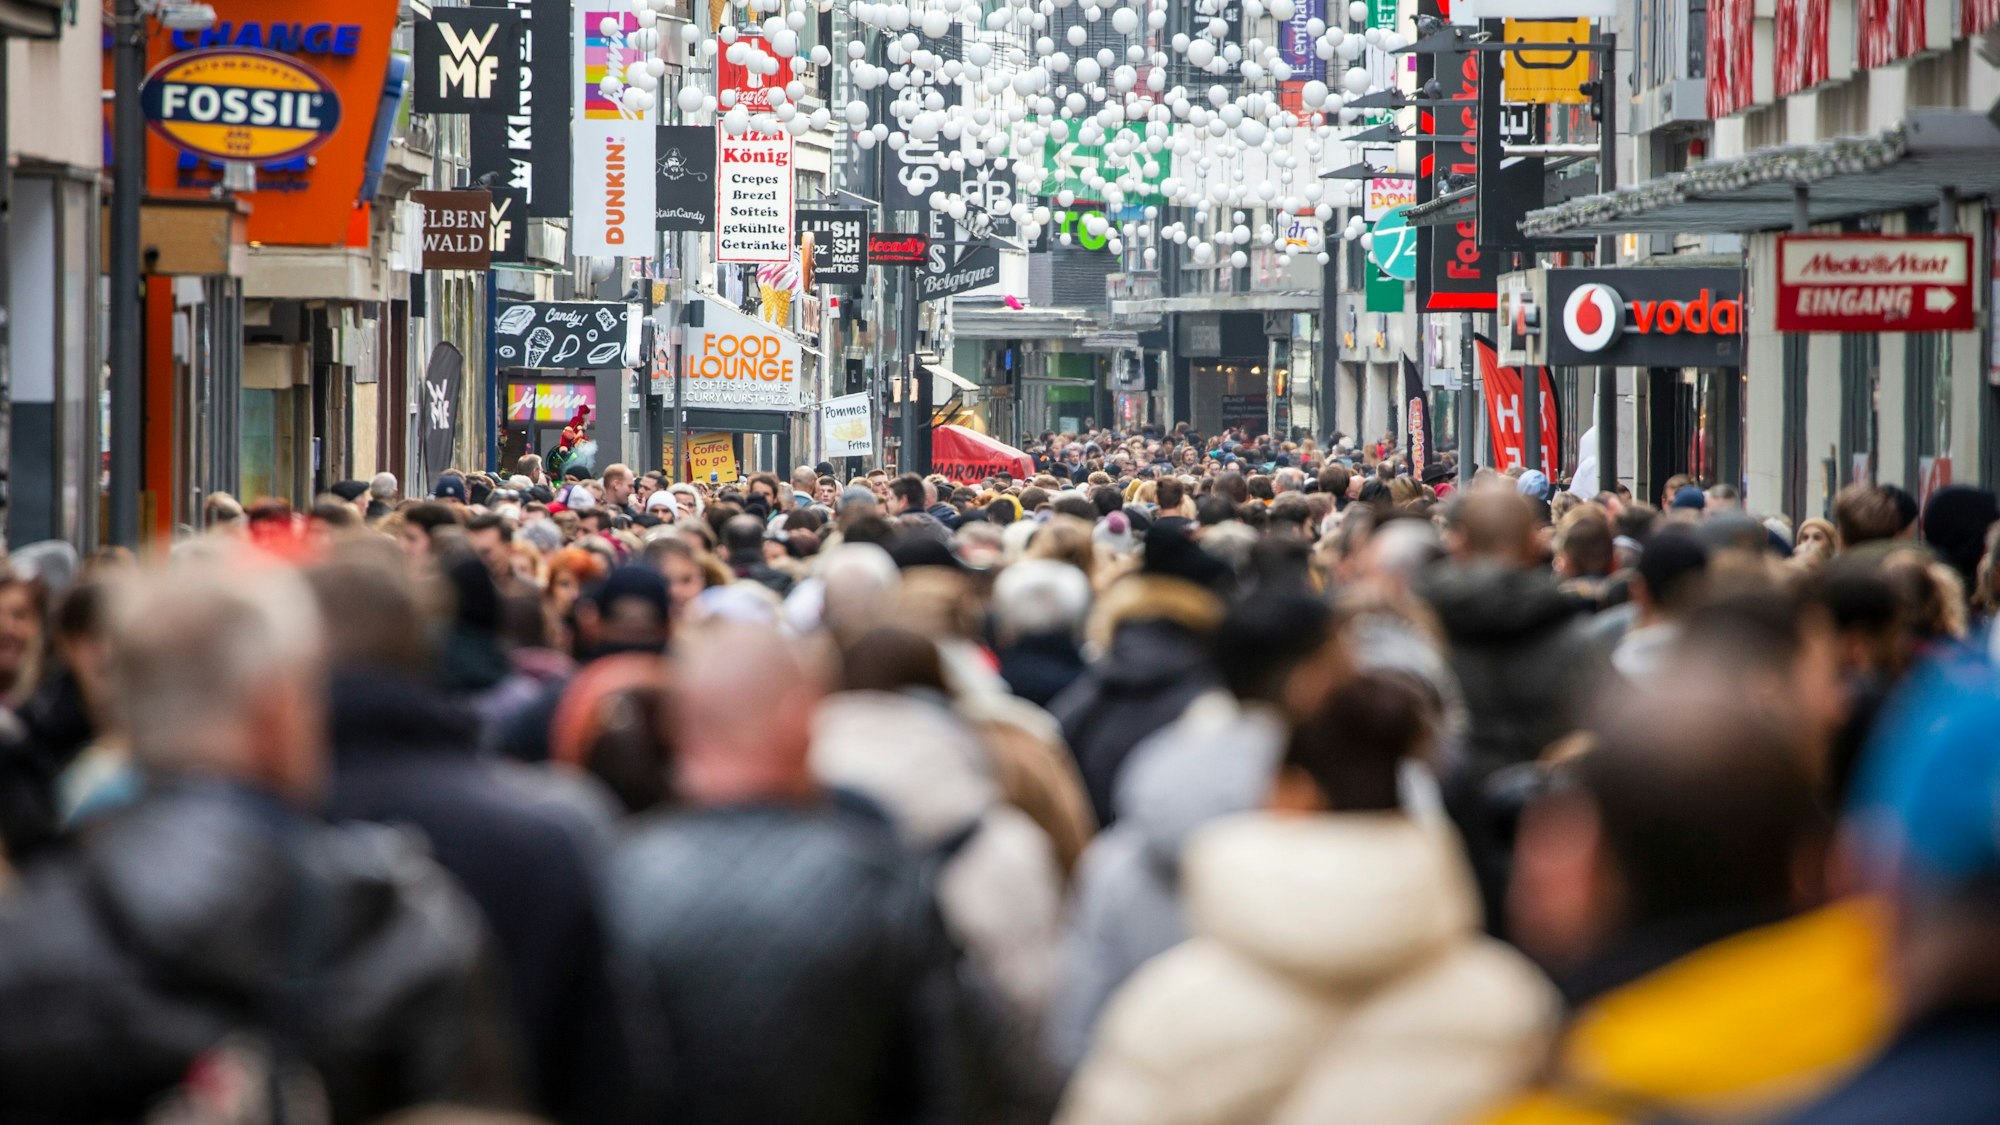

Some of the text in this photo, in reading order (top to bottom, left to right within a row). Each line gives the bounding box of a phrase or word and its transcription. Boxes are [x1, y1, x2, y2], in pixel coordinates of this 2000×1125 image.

[172, 22, 361, 55] CHANGE
[436, 22, 499, 98] WMF
[161, 84, 321, 128] FOSSIL
[723, 148, 788, 166] König
[731, 174, 779, 186] Crepes
[732, 190, 777, 200] Brezel
[677, 208, 705, 224] Candy
[730, 206, 779, 217] Softeis
[723, 223, 785, 235] gekühlte
[721, 239, 787, 251] Getränke
[924, 266, 994, 294] Belgique
[1796, 287, 1913, 318] EINGANG
[545, 308, 588, 328] Candy!
[1632, 288, 1743, 336] voda
[704, 334, 781, 358] FOOD
[690, 355, 794, 382] LOUNGE
[693, 380, 789, 393] SOFTEIS POMMES
[767, 395, 795, 405] PIZZA
[825, 404, 867, 419] Pommes
[692, 443, 729, 455] Coffee
[848, 440, 870, 450] Frites
[695, 455, 728, 467] to go
